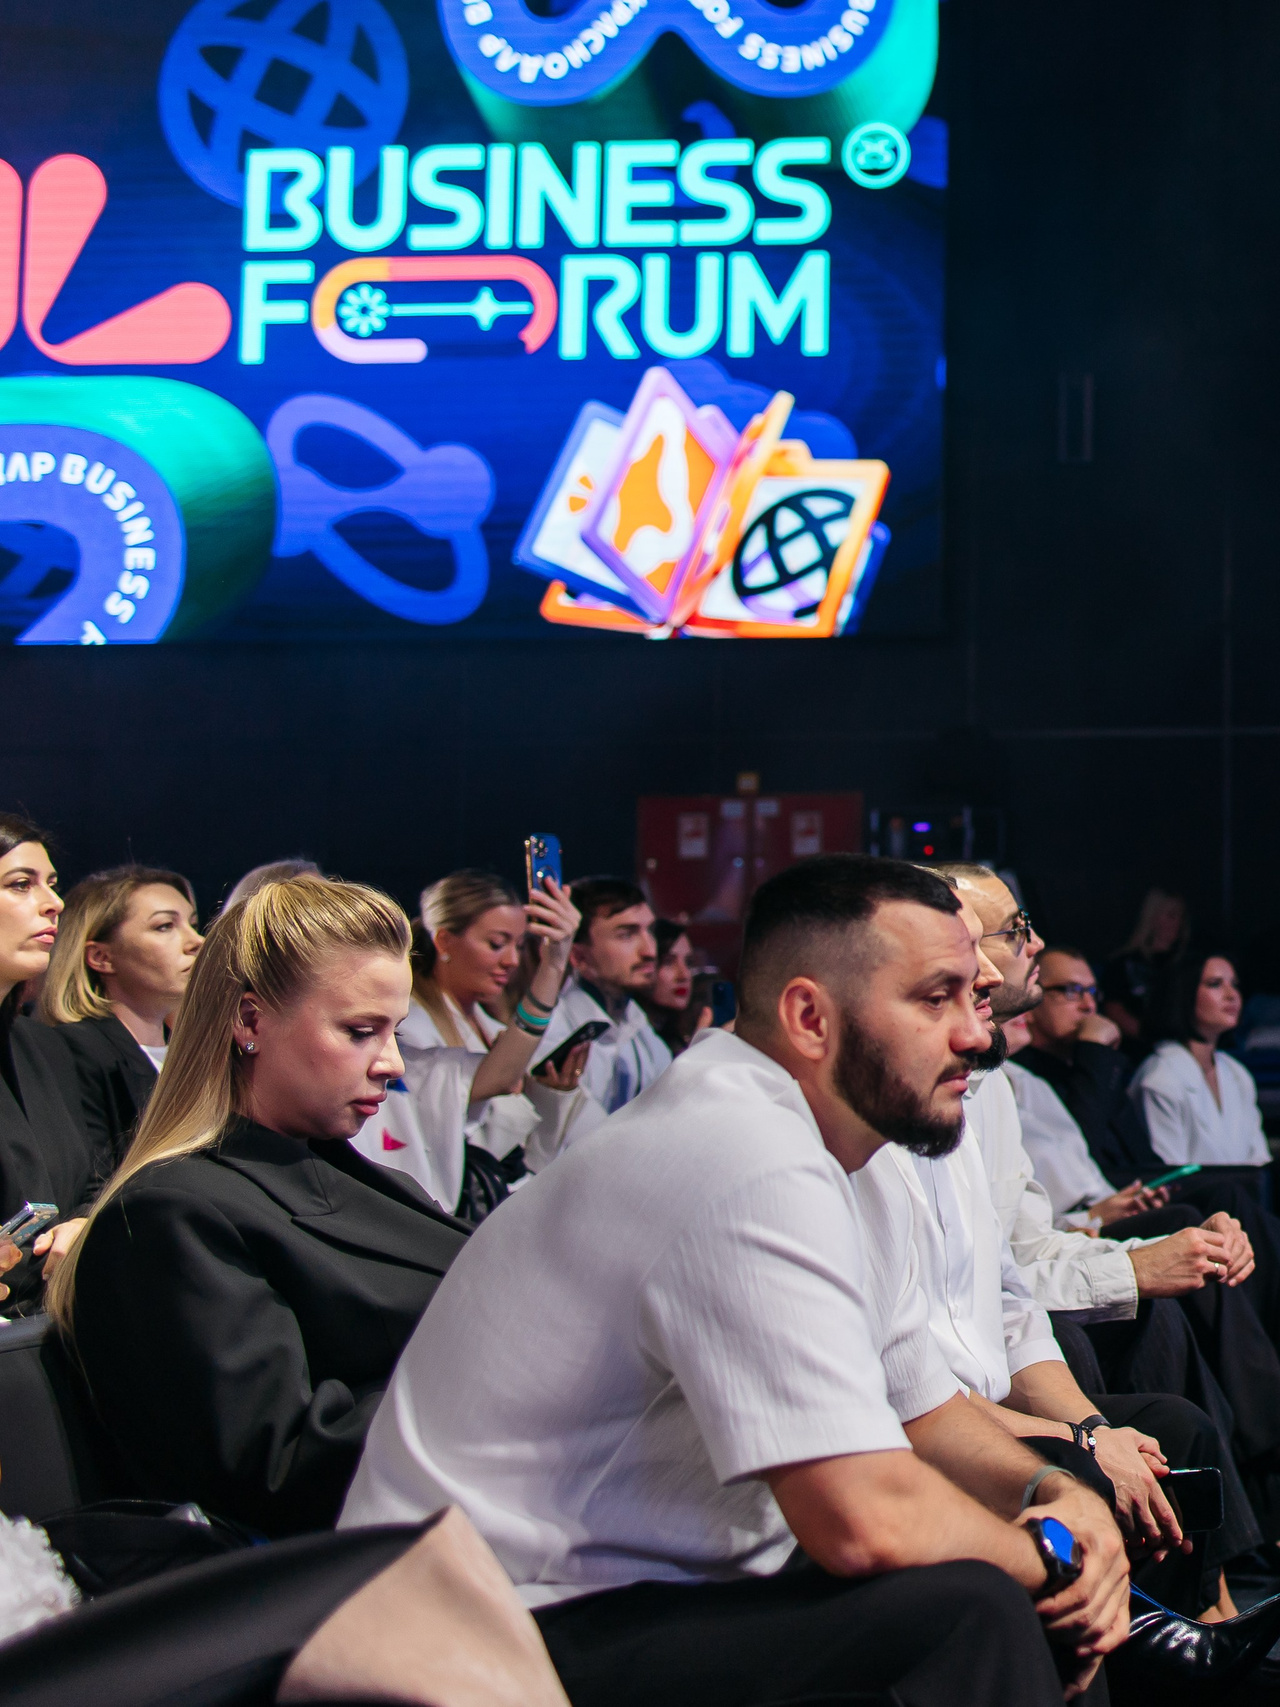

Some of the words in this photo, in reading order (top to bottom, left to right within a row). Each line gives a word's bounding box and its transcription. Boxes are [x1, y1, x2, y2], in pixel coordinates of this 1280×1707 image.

[243, 137, 831, 252] BUSINESS
[239, 251, 830, 364] FORUM
[60, 453, 156, 624] BUSINESS
